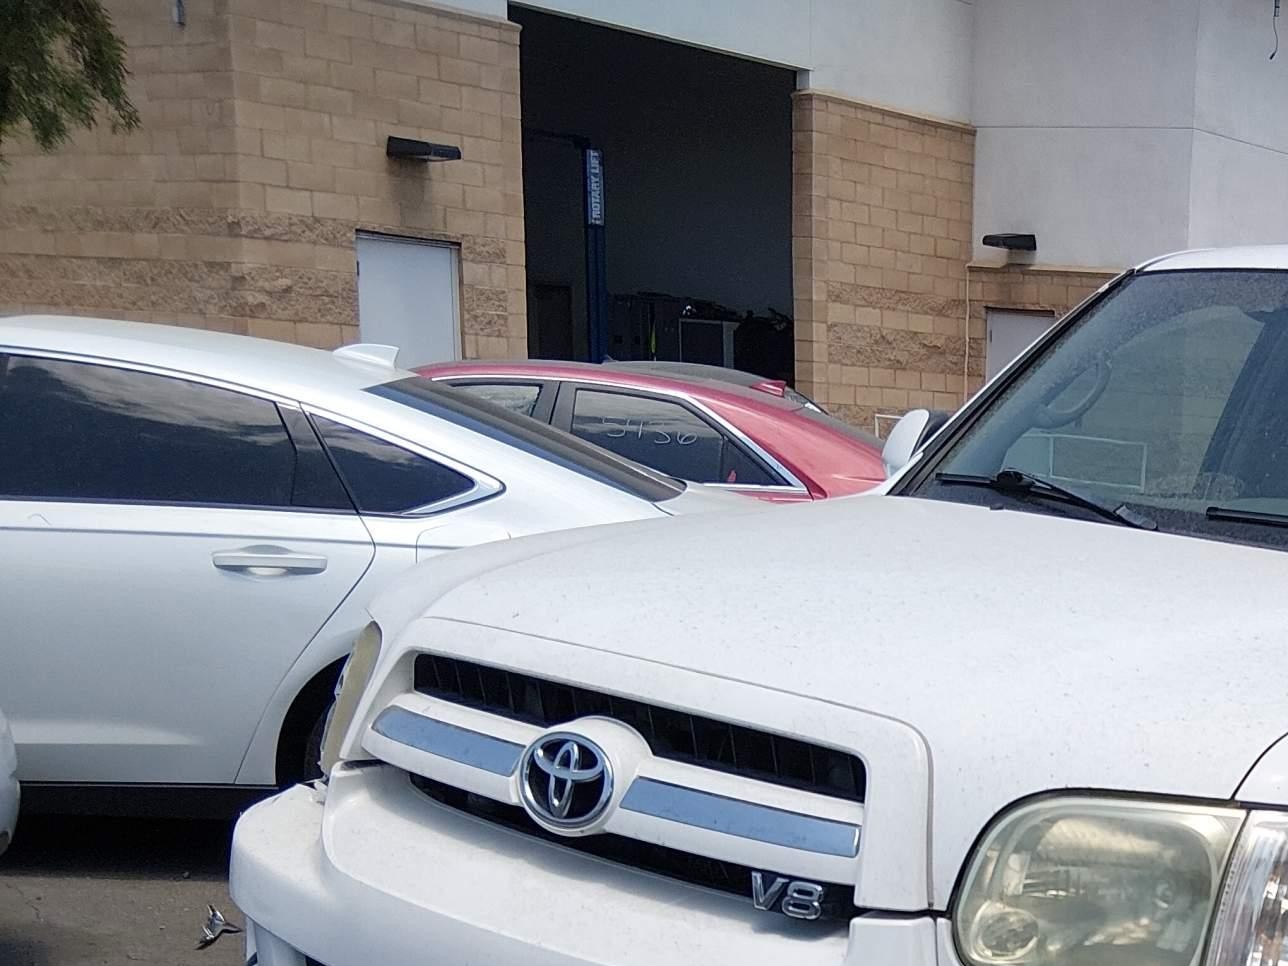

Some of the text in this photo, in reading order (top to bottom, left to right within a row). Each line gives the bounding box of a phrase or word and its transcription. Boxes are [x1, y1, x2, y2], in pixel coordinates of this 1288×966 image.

[590, 149, 601, 219] ROTARY LIFT
[751, 871, 824, 920] V8
